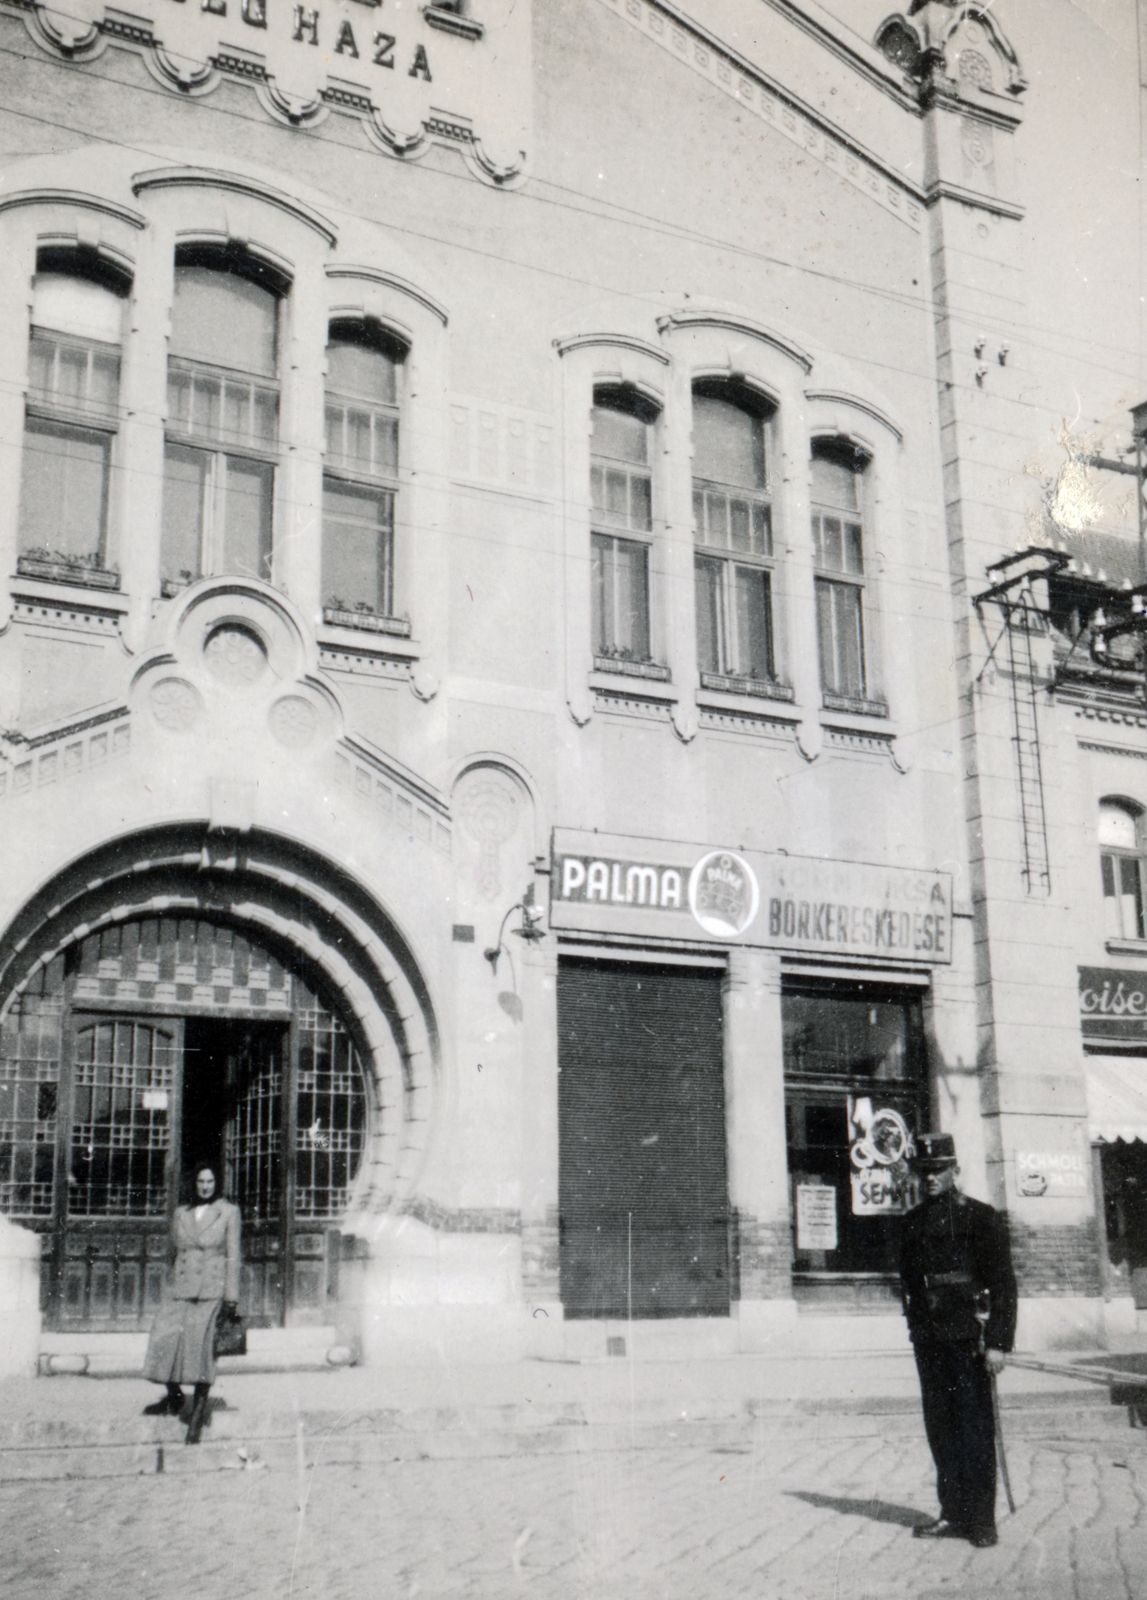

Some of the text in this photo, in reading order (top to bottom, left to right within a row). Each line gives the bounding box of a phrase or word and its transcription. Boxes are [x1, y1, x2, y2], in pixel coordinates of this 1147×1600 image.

[562, 858, 681, 908] PALMA
[707, 867, 742, 891] PALMA
[1079, 980, 1147, 1015] oise
